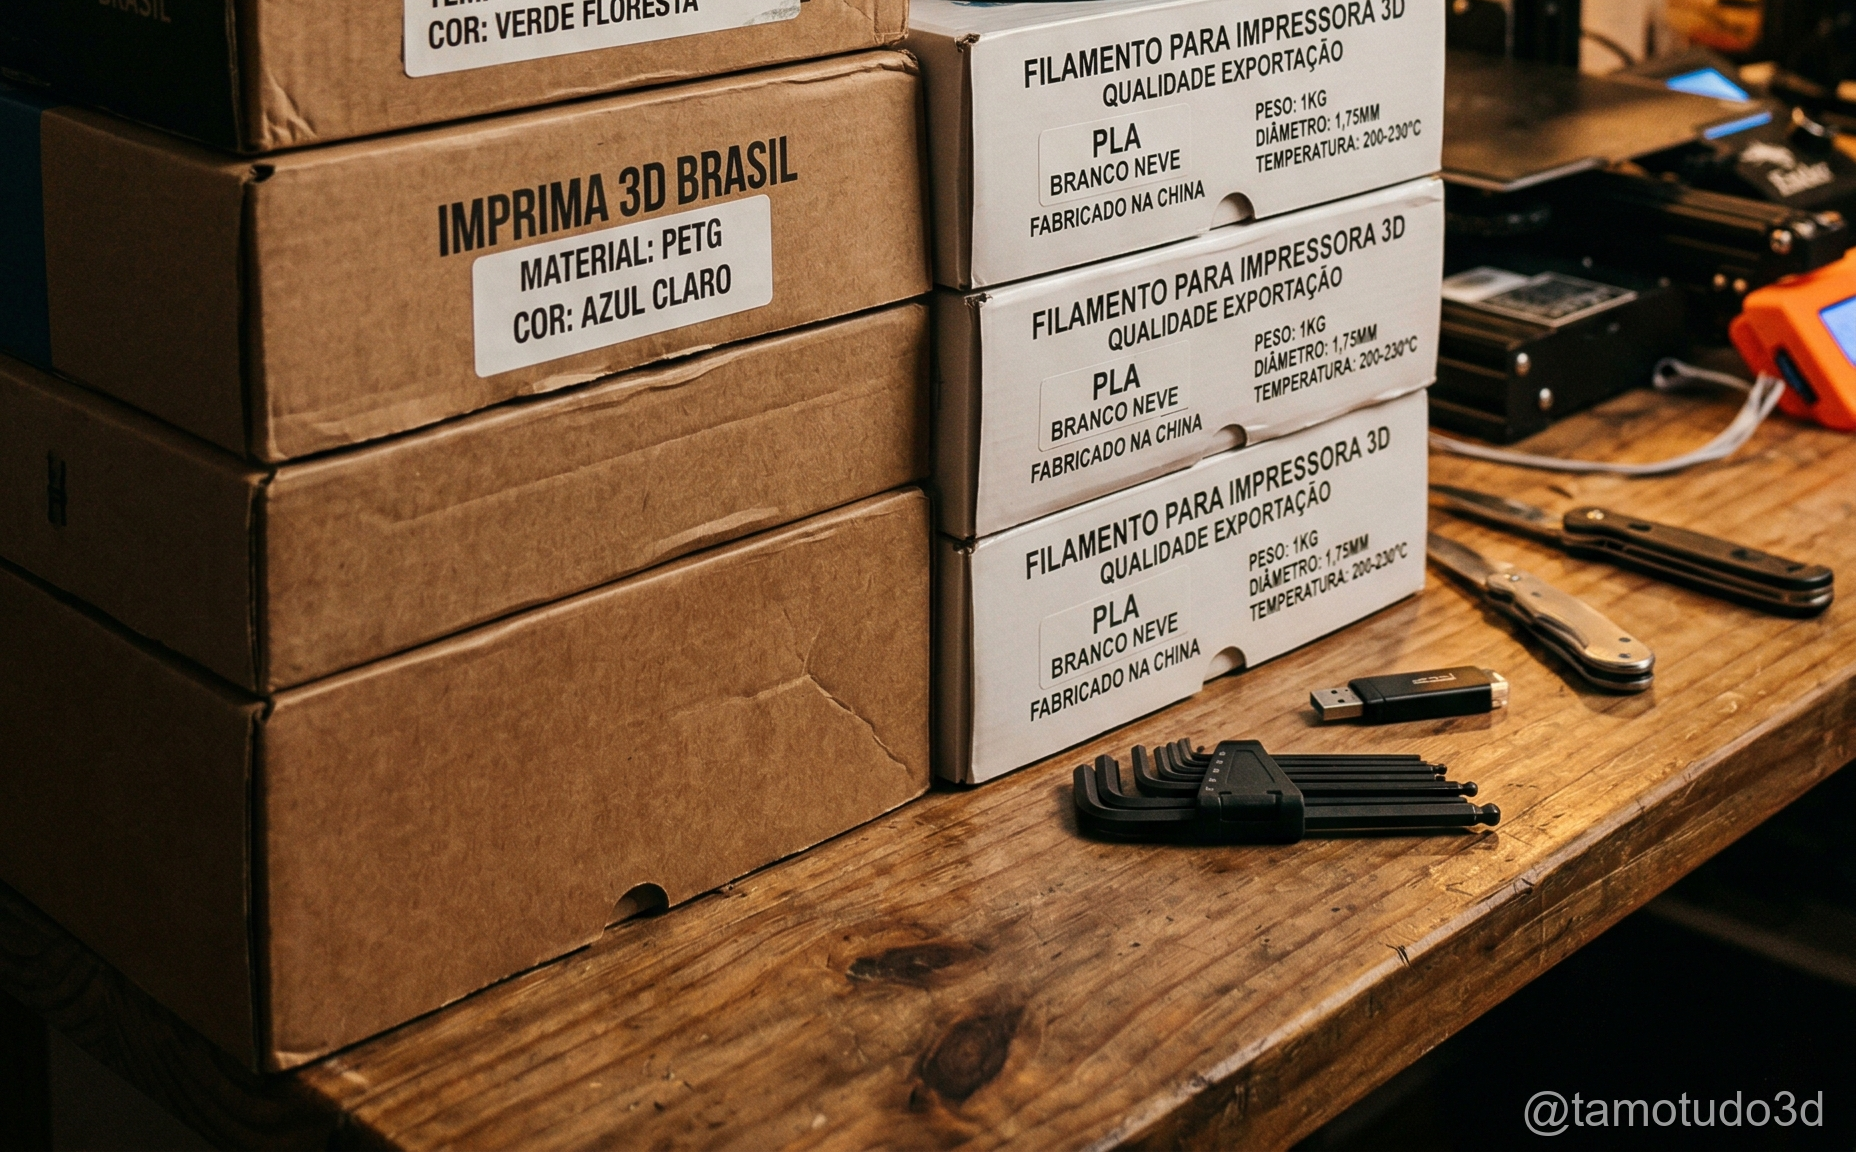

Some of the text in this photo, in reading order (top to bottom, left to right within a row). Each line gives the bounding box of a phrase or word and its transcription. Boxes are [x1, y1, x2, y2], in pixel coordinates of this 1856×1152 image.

[429, 16, 488, 50] COR:
[496, 2, 574, 39] VERDE
[1024, 37, 1162, 88] FILAMENTO
[1170, 25, 1230, 60] PARA
[1237, 0, 1375, 48] IMPRESSORA
[1103, 38, 1343, 107] QUALIDADE EXPORTAÇÃO
[1255, 89, 1327, 120] PESO: 1KG
[1256, 103, 1379, 147] DIÂMETRO: 1,75MM
[1093, 123, 1141, 157] PLA
[1256, 135, 1359, 173] TEMPERATURA:
[438, 136, 798, 257] IMPRIMA 3D BRASIL
[1050, 149, 1180, 196] BRANCO NEVE
[1030, 180, 1205, 237] FABRICADO NA CHINA
[521, 218, 722, 292] MATERIAL: PETG
[1033, 215, 1405, 340] FILAMENTO PARA IMPRESSORA 3D
[514, 264, 731, 344] COR: AZUL CLARO
[1109, 266, 1342, 351] QUALIDADE EXPORTAÇÃO
[1255, 315, 1326, 351] PESO: 1KG
[1255, 323, 1377, 378] DIÂMETRO: 1,75MM
[1093, 363, 1140, 400] PLA
[1254, 360, 1355, 403] TEMPERATURA:
[1051, 386, 1178, 442] BRANCO NEVE
[1031, 413, 1202, 483] FABRICADO NA CHINA
[1026, 426, 1390, 579] FILAMENTO PARA IMPRESSORA 3D
[1100, 480, 1331, 585] QUALIDADE EXPORTAÇÃO
[1249, 530, 1318, 571] PESO: 1KG
[1249, 555, 1321, 596] DIÂMETRO:
[1250, 571, 1349, 621] TEMPERATURA:
[1093, 593, 1139, 634] PLA
[1051, 612, 1178, 679] BRANCO NEVE
[1030, 639, 1200, 721] FABRICADO NA CHINA
